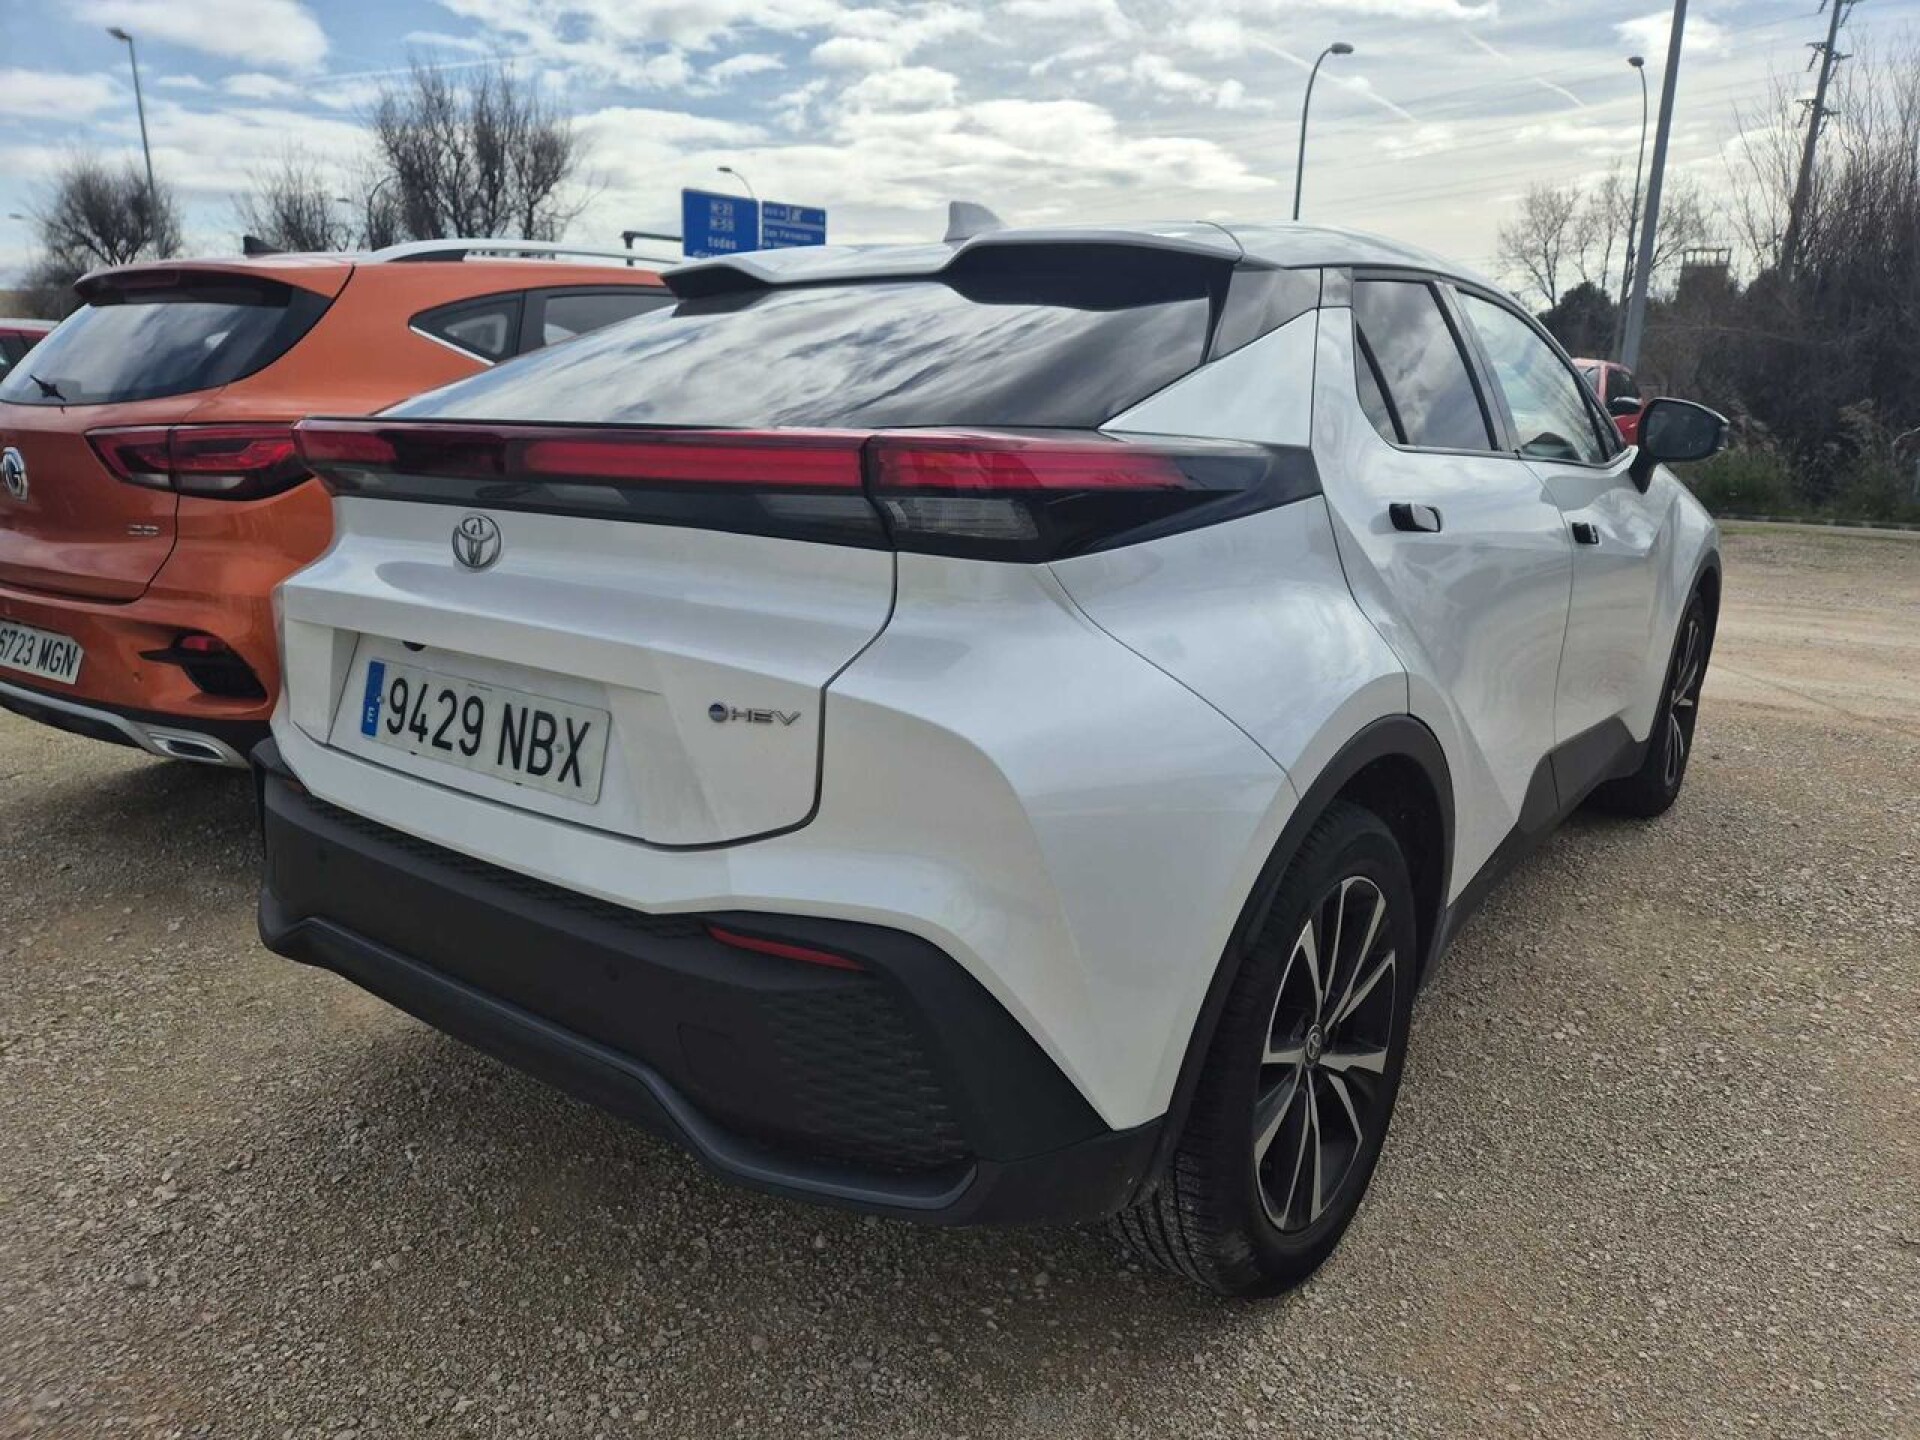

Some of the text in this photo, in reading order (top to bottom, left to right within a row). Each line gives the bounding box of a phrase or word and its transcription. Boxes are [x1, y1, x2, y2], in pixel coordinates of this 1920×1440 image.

[37, 638, 78, 677] MGN
[367, 706, 376, 723] E
[731, 706, 802, 726] HEV
[386, 677, 592, 787] 9429 NBX
